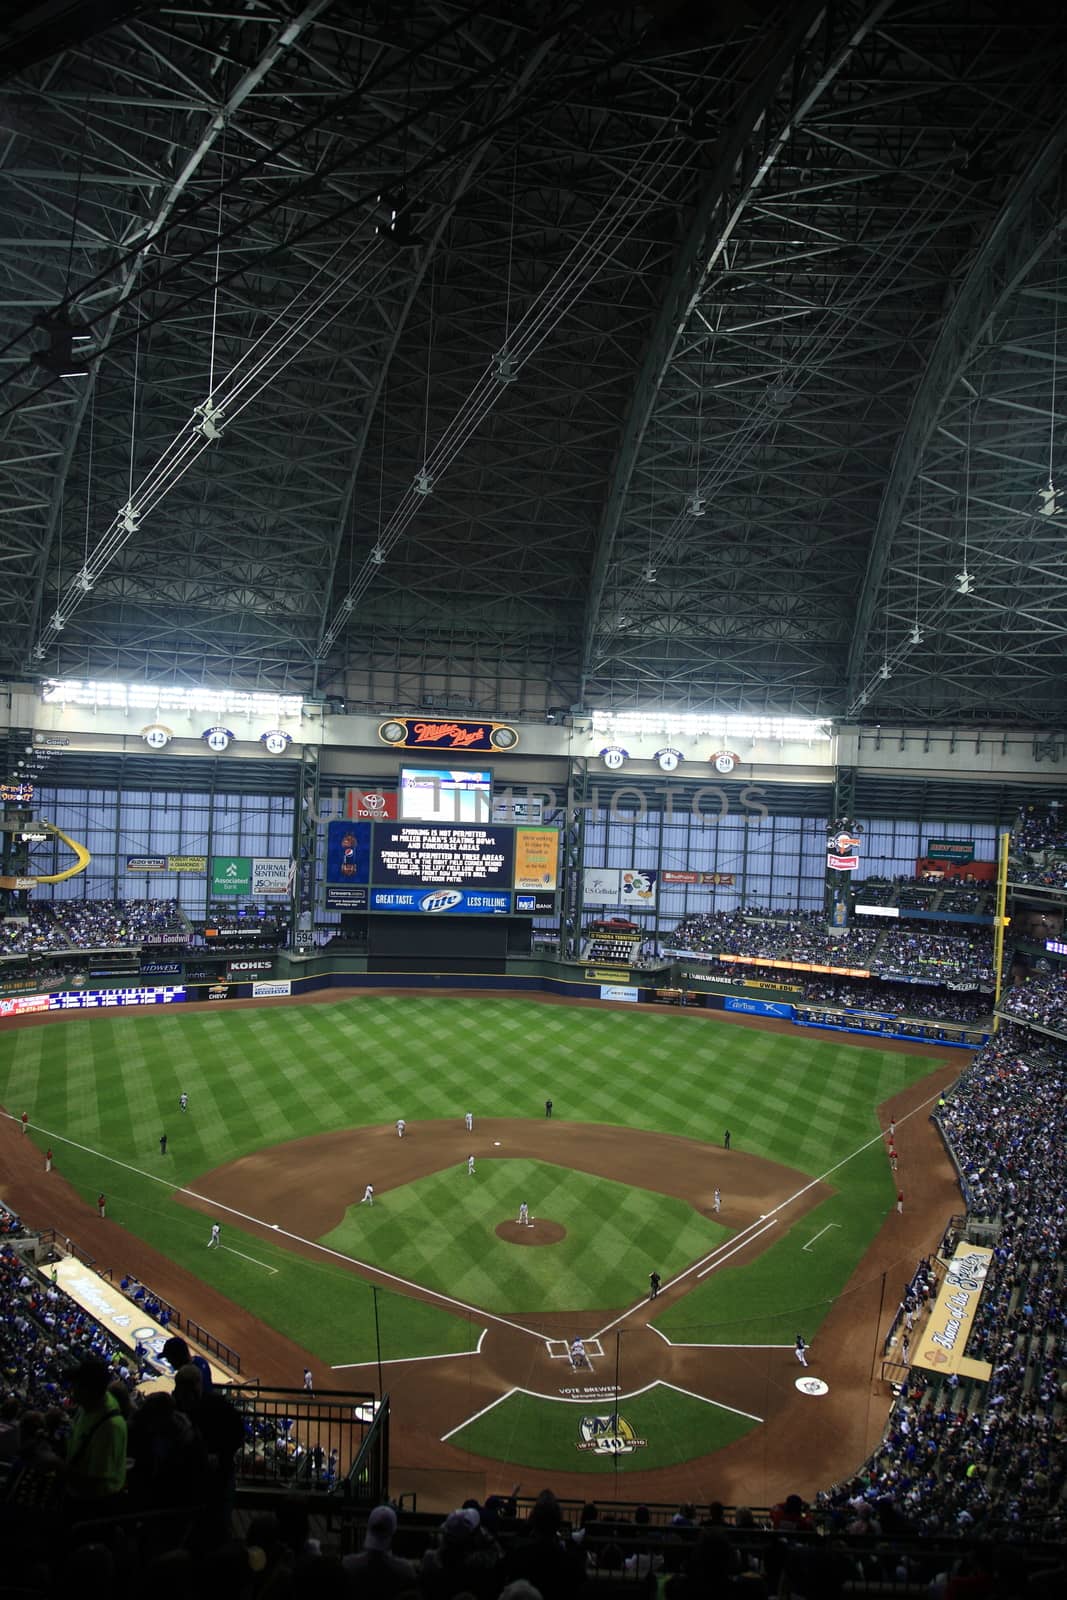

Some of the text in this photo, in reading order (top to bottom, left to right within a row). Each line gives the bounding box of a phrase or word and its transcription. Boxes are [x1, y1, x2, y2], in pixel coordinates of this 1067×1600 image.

[150, 732, 164, 743] 42
[413, 723, 485, 748] Miller Park
[210, 736, 225, 746] 44
[269, 738, 283, 749] 34
[608, 755, 621, 765] 19
[664, 756, 671, 767] 4
[719, 758, 730, 766] 50
[358, 809, 389, 817] TOYOTA
[401, 828, 430, 836] SMOKING
[439, 829, 451, 837] NOT
[452, 830, 487, 838] PERMITTED
[448, 836, 474, 844] SEATING
[381, 850, 409, 858] SMOKING
[410, 851, 417, 859] IS
[419, 852, 452, 860] PERMITTED
[462, 853, 480, 861] THESE
[255, 864, 287, 872] JOURNAL
[375, 894, 394, 904] GREAT
[395, 895, 415, 905] TASTE.
[467, 896, 482, 907] LESS
[147, 933, 190, 943] Club Goodwill
[296, 932, 313, 943] 594
[230, 961, 273, 970] KOHL'S
[759, 982, 793, 991] UWM.EDU
[949, 1291, 969, 1307] the
[944, 1301, 969, 1318] of
[932, 1319, 961, 1350] Home
[559, 1385, 622, 1394] VOTE BREWERS
